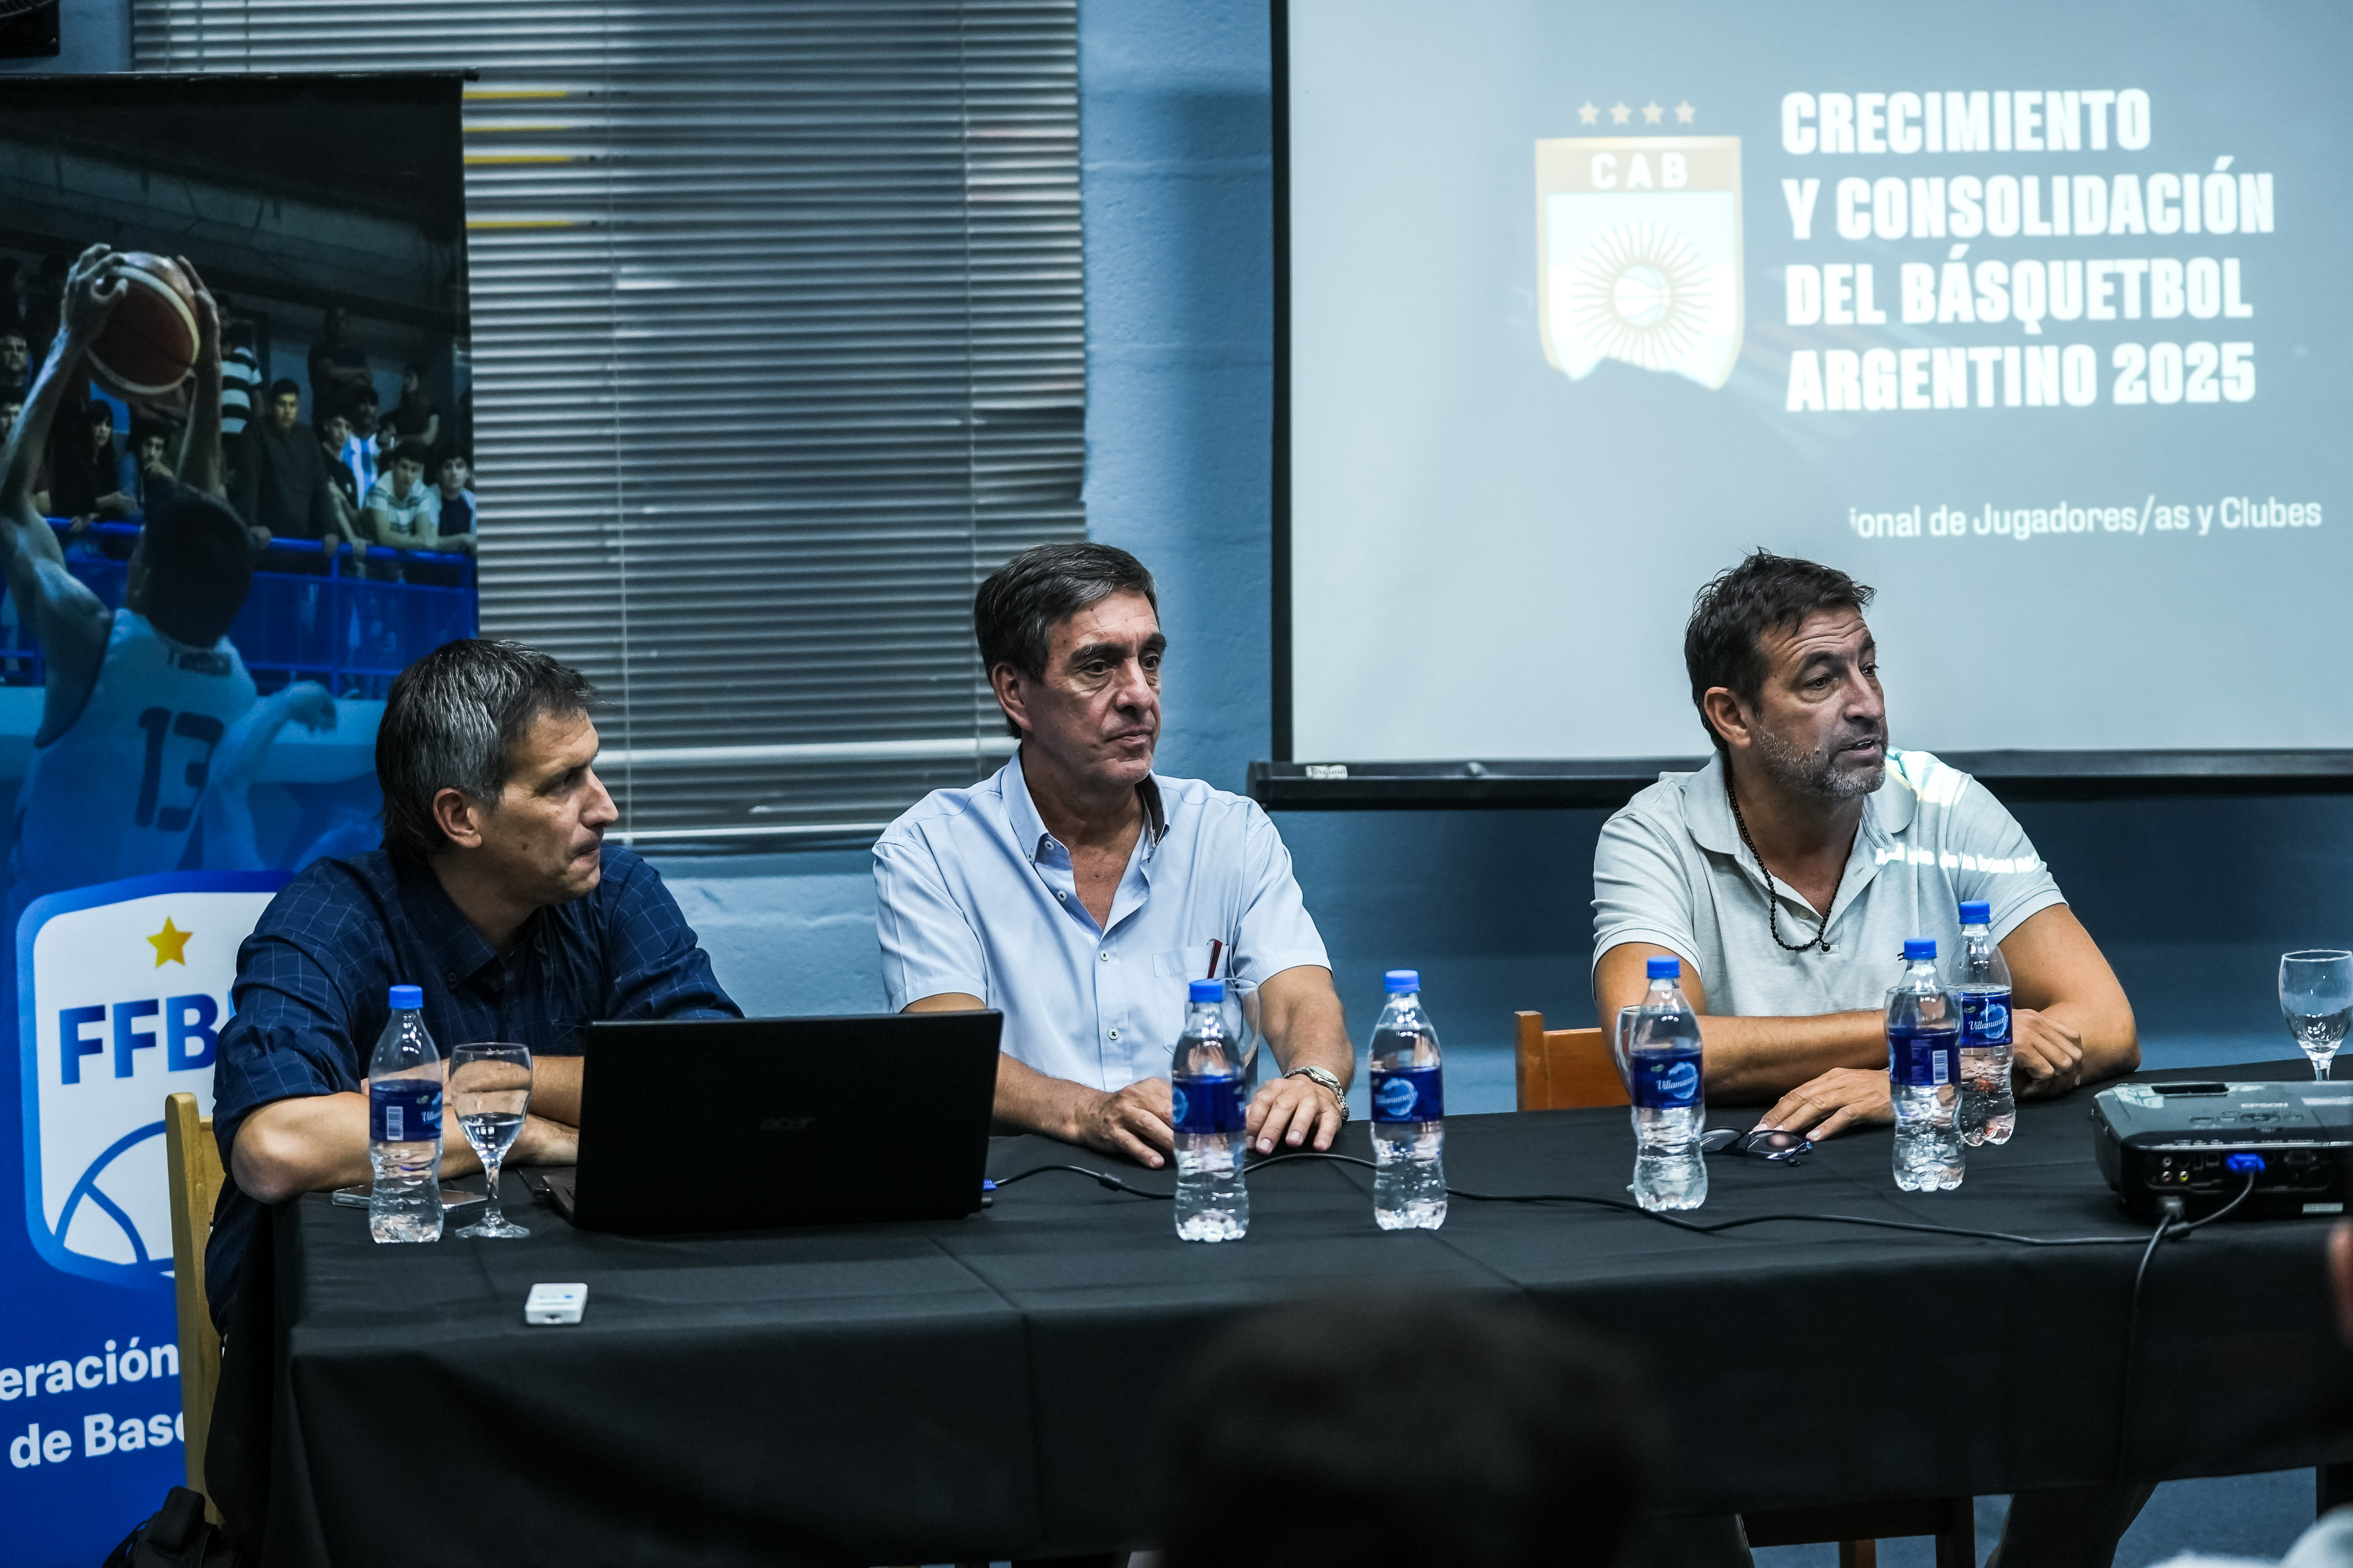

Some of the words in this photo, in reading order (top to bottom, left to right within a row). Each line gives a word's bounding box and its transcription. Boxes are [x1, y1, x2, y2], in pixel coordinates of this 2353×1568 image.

[1781, 88, 2151, 155] CRECIMIENTO
[1591, 152, 1688, 190] CAB
[1781, 177, 1821, 240] Y
[1835, 155, 2274, 241] CONSOLIDACIÓN
[1786, 263, 1887, 326] DEL
[1900, 243, 2254, 335] BÁSQUETBOL
[1786, 343, 2098, 412] ARGENTINO
[2112, 341, 2256, 405] 2025
[1929, 503, 1966, 536] de
[1973, 495, 2190, 540] Jugadores/as
[2196, 504, 2214, 536] y
[2220, 496, 2323, 529] Clubes
[134, 706, 225, 832] 13
[59, 989, 237, 1085] FFB
[0, 1336, 179, 1401] eración
[10, 1423, 72, 1469] de
